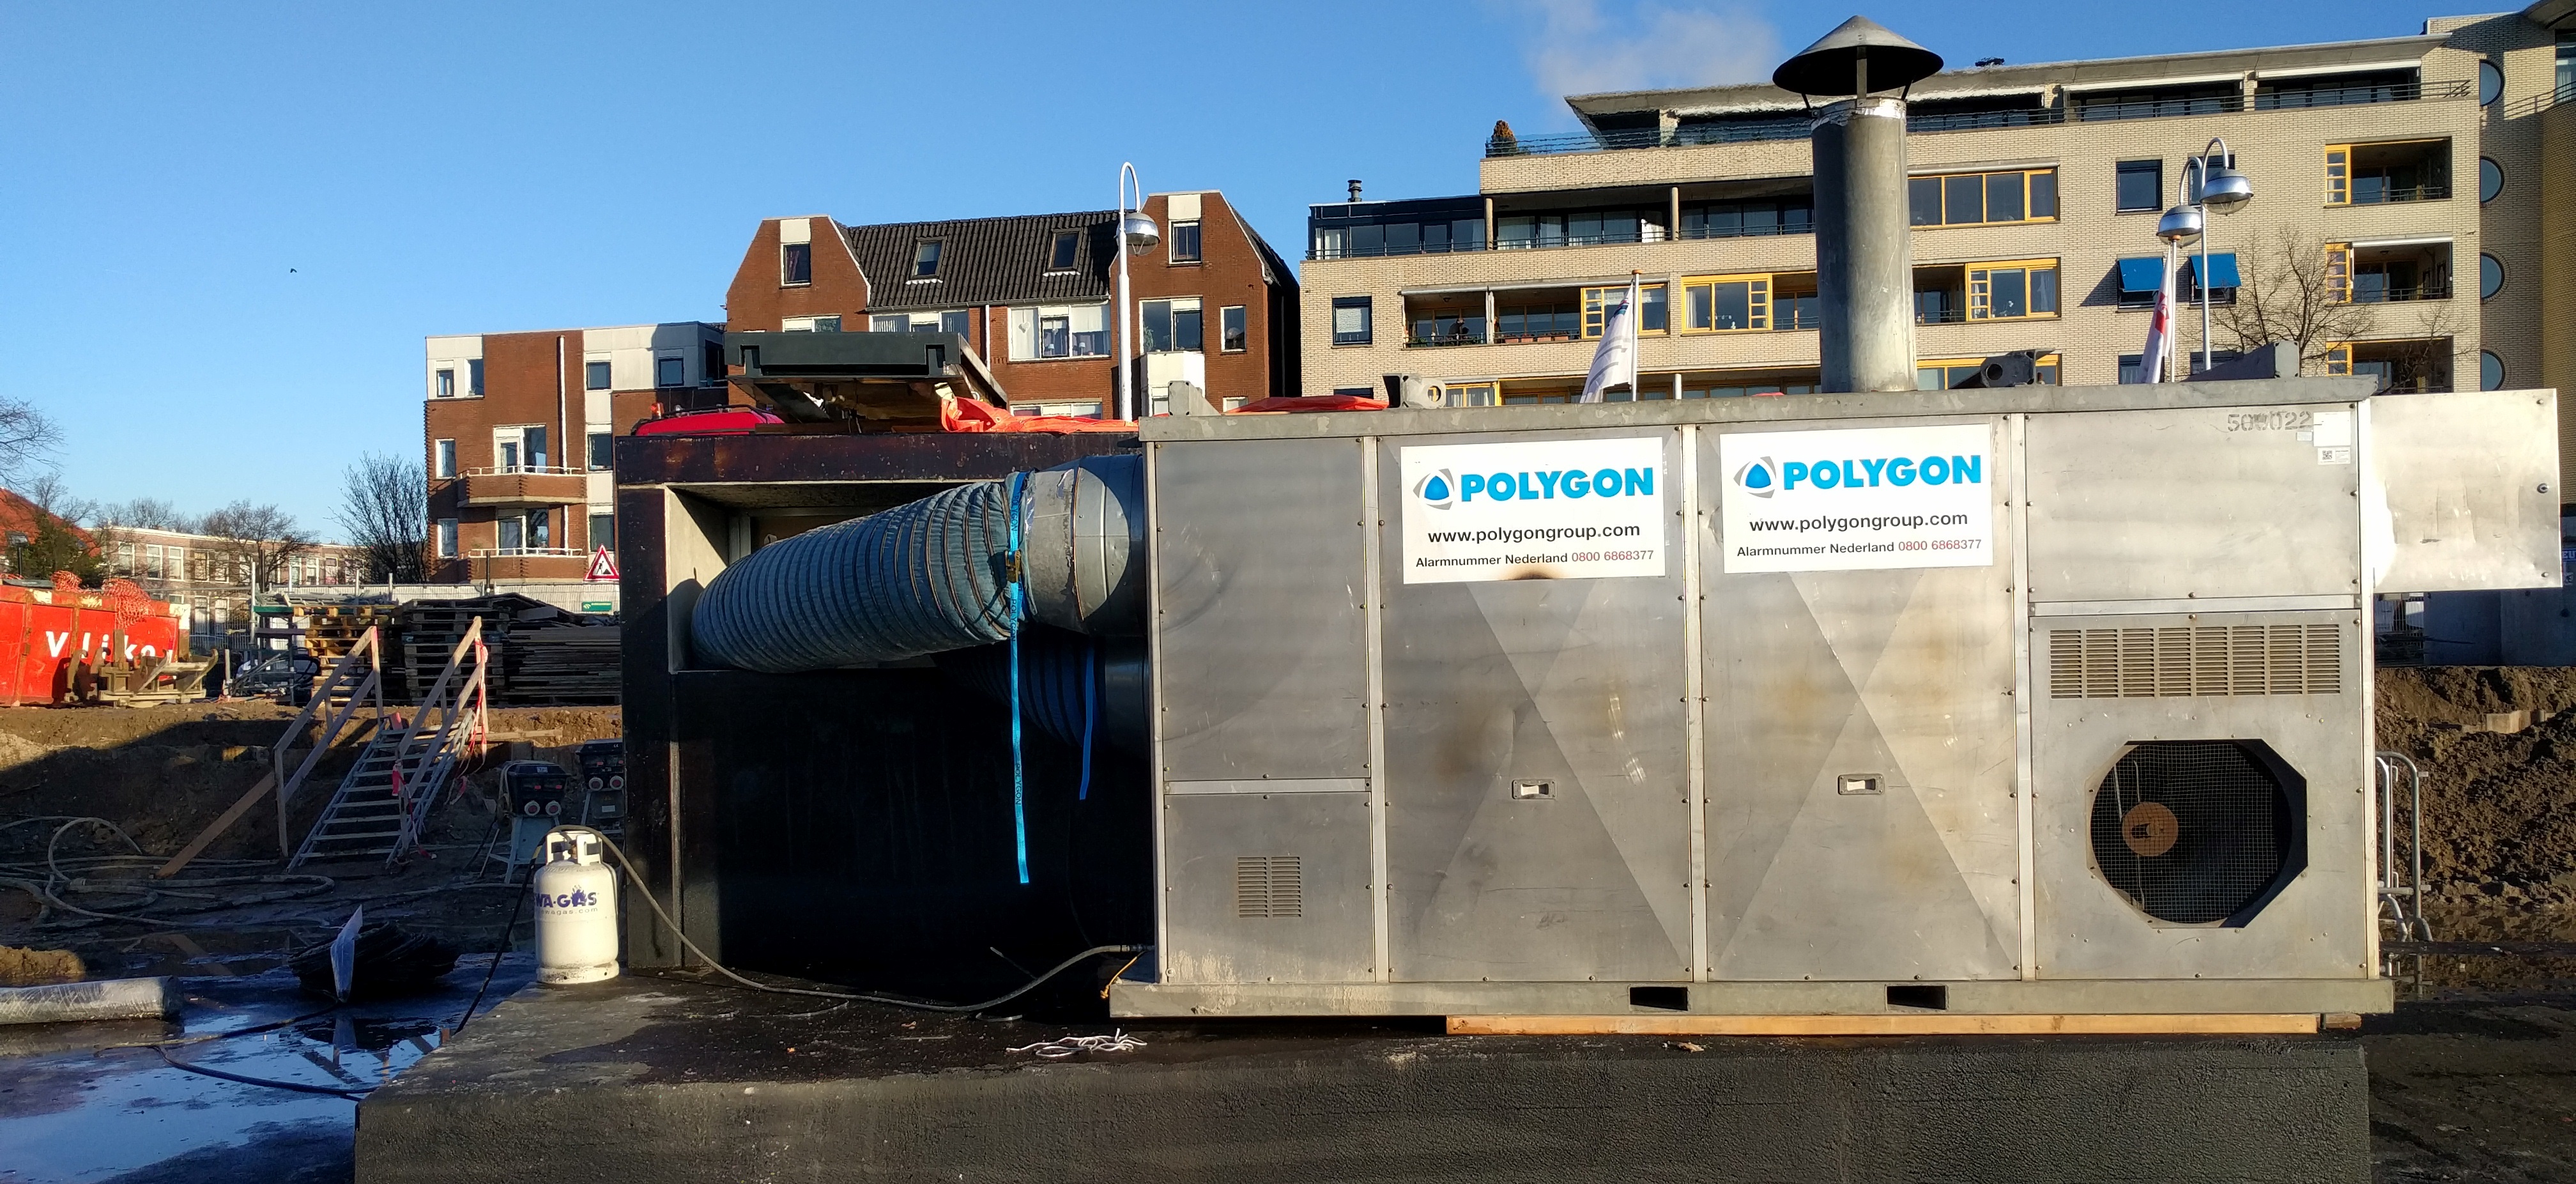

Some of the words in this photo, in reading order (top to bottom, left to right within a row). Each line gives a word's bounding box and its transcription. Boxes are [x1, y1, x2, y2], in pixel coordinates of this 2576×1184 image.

[1782, 455, 1981, 490] POLYGON
[1461, 467, 1653, 502] POLYGON
[1749, 512, 1968, 532] www.polygongroup.com
[1428, 524, 1640, 544] www.polygongroup.com
[1737, 546, 1826, 557] Alarmnummer
[1830, 542, 1894, 553] Nederland
[1898, 541, 1928, 551] 0800
[1931, 539, 1982, 550] 6868377
[1416, 556, 1501, 567] Alarmnummer
[1505, 553, 1568, 564] Nederland
[1572, 551, 1600, 562] 0800
[1604, 550, 1654, 561] 6868377
